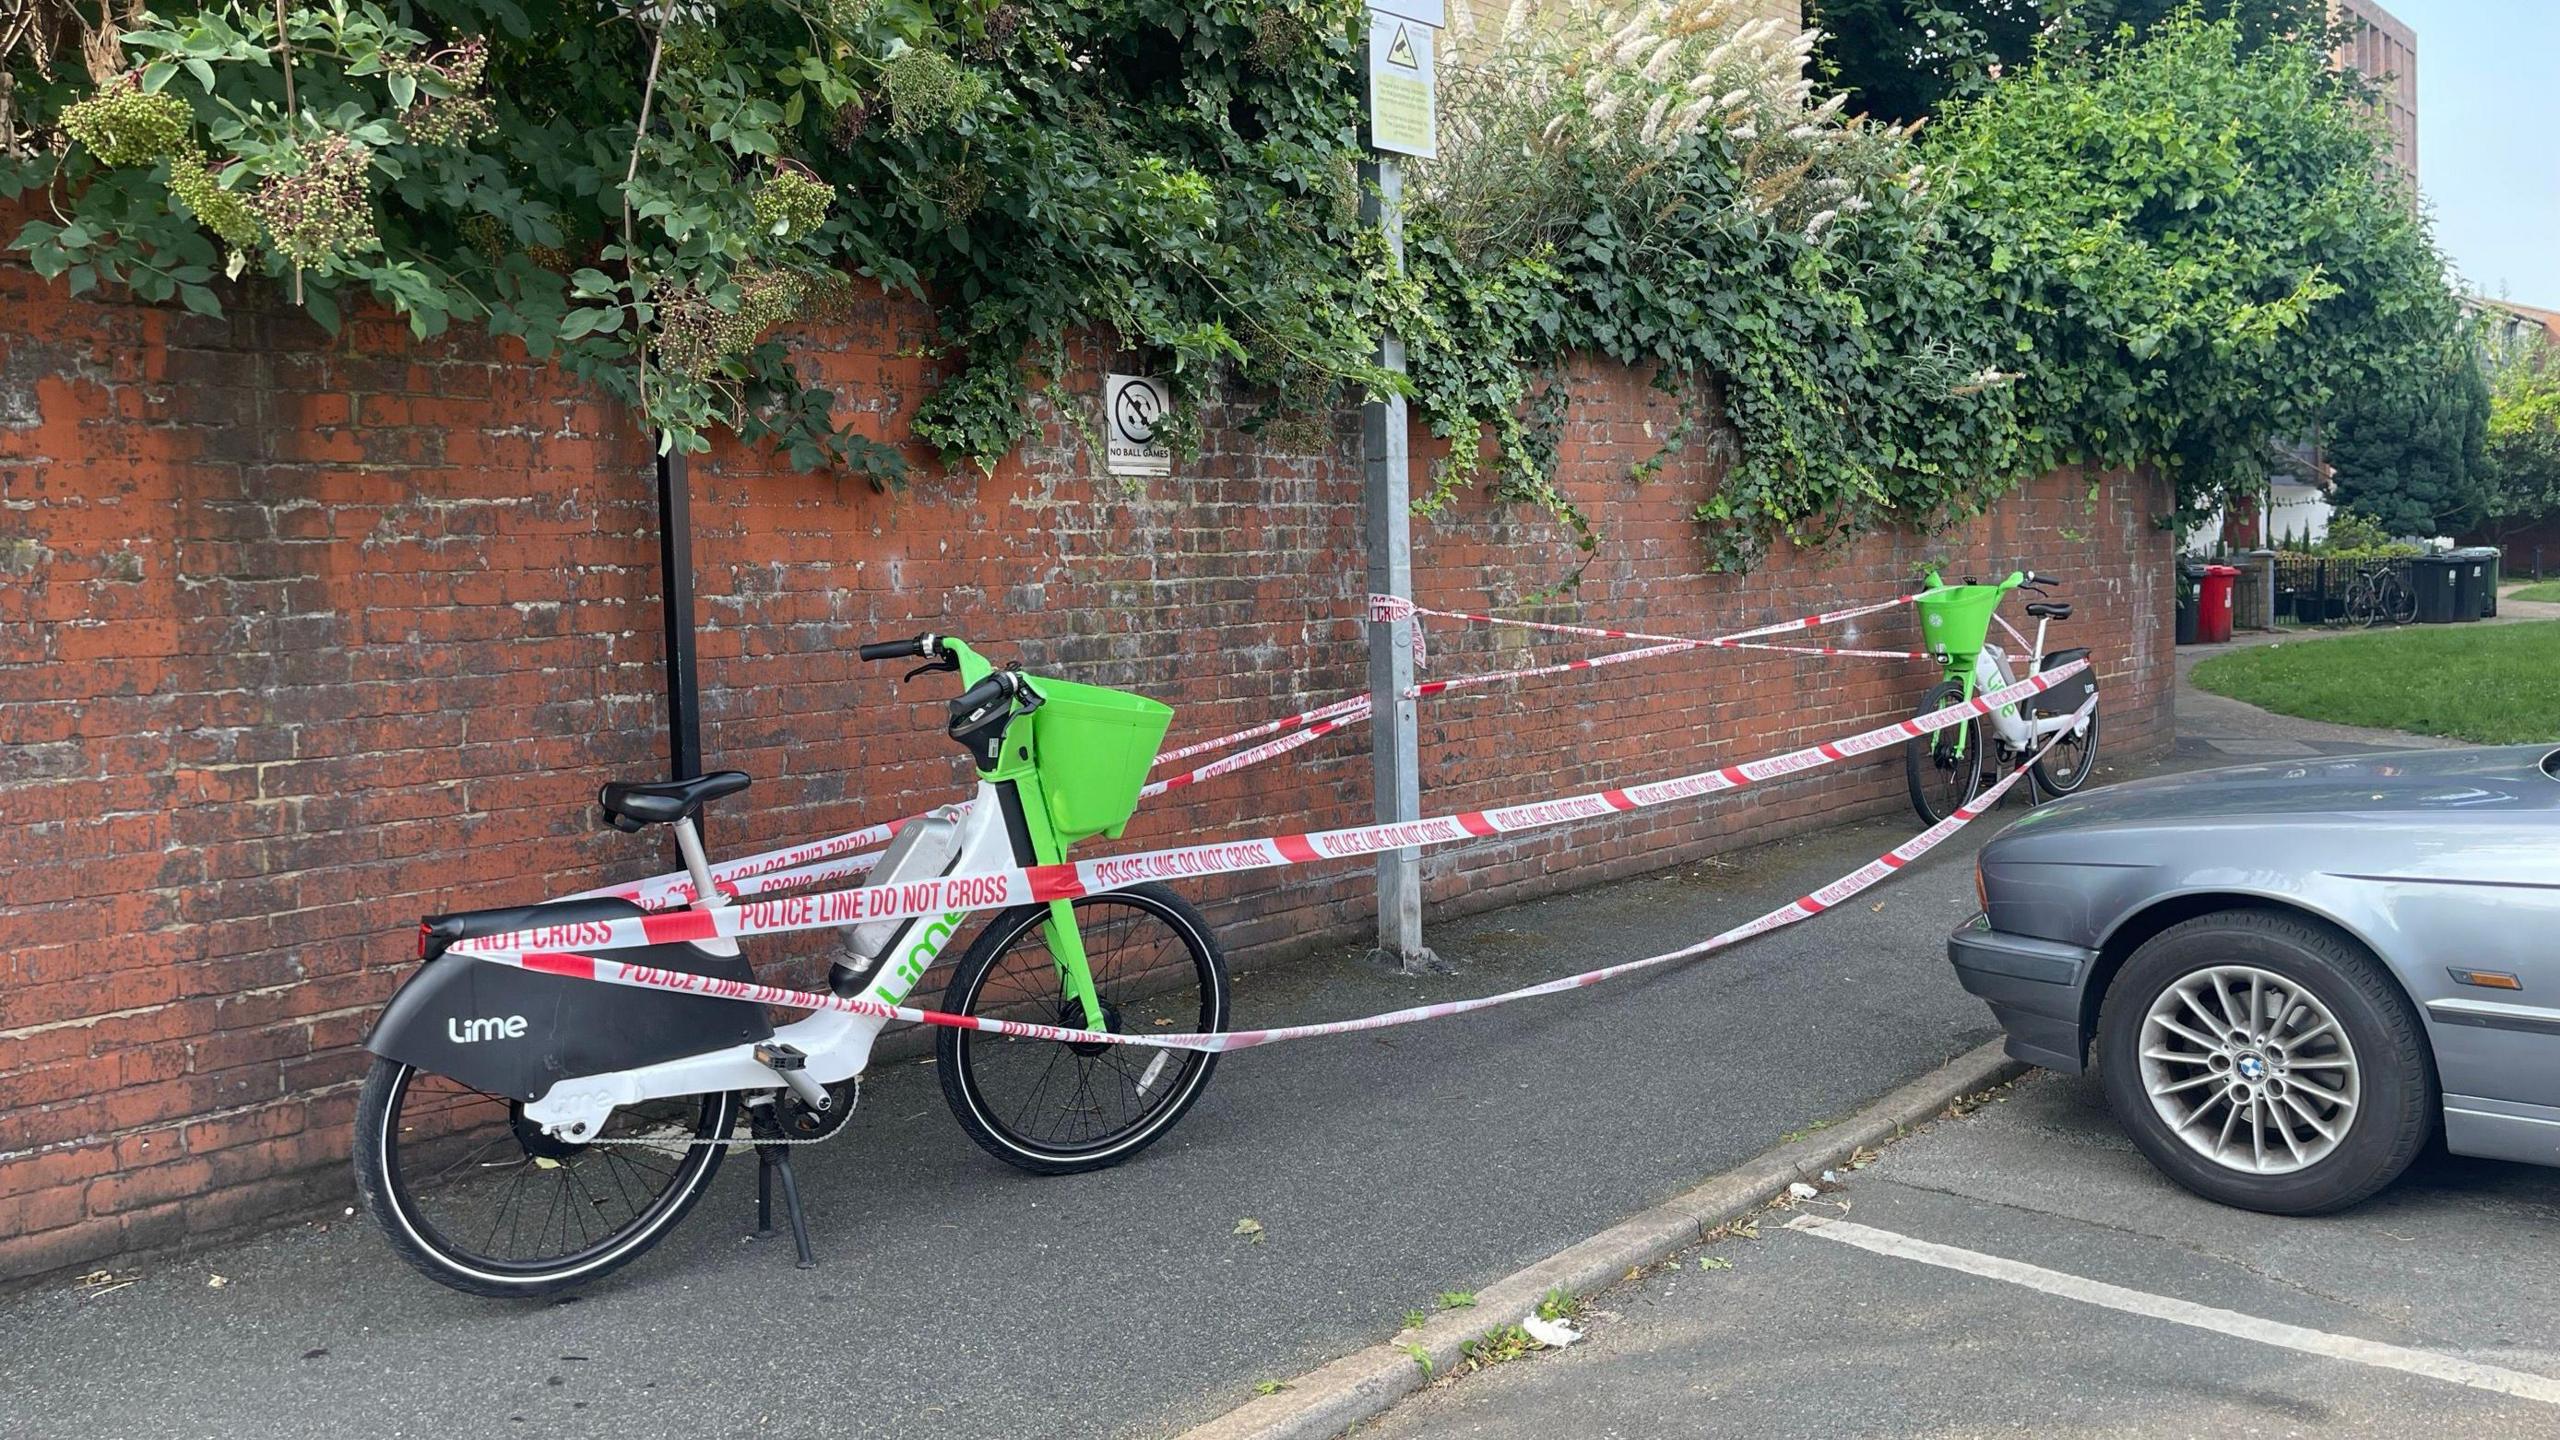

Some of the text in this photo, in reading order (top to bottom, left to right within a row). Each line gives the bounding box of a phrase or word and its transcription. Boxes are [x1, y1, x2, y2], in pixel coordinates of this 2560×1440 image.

[1110, 448, 1169, 458] NO BALL GAMES
[1496, 798, 1606, 829] POLICE LINE DO NOT CROSS
[1322, 820, 1458, 855] POLICE LINE DO NOT CROSS
[1096, 843, 1271, 887] POLICE LINE DO NOT CROSS
[740, 875, 1007, 931] POLICE LINE DO NOT CROSS
[532, 920, 613, 949] CROSS
[875, 912, 967, 1005] Lim
[448, 1015, 528, 1044] Lime
